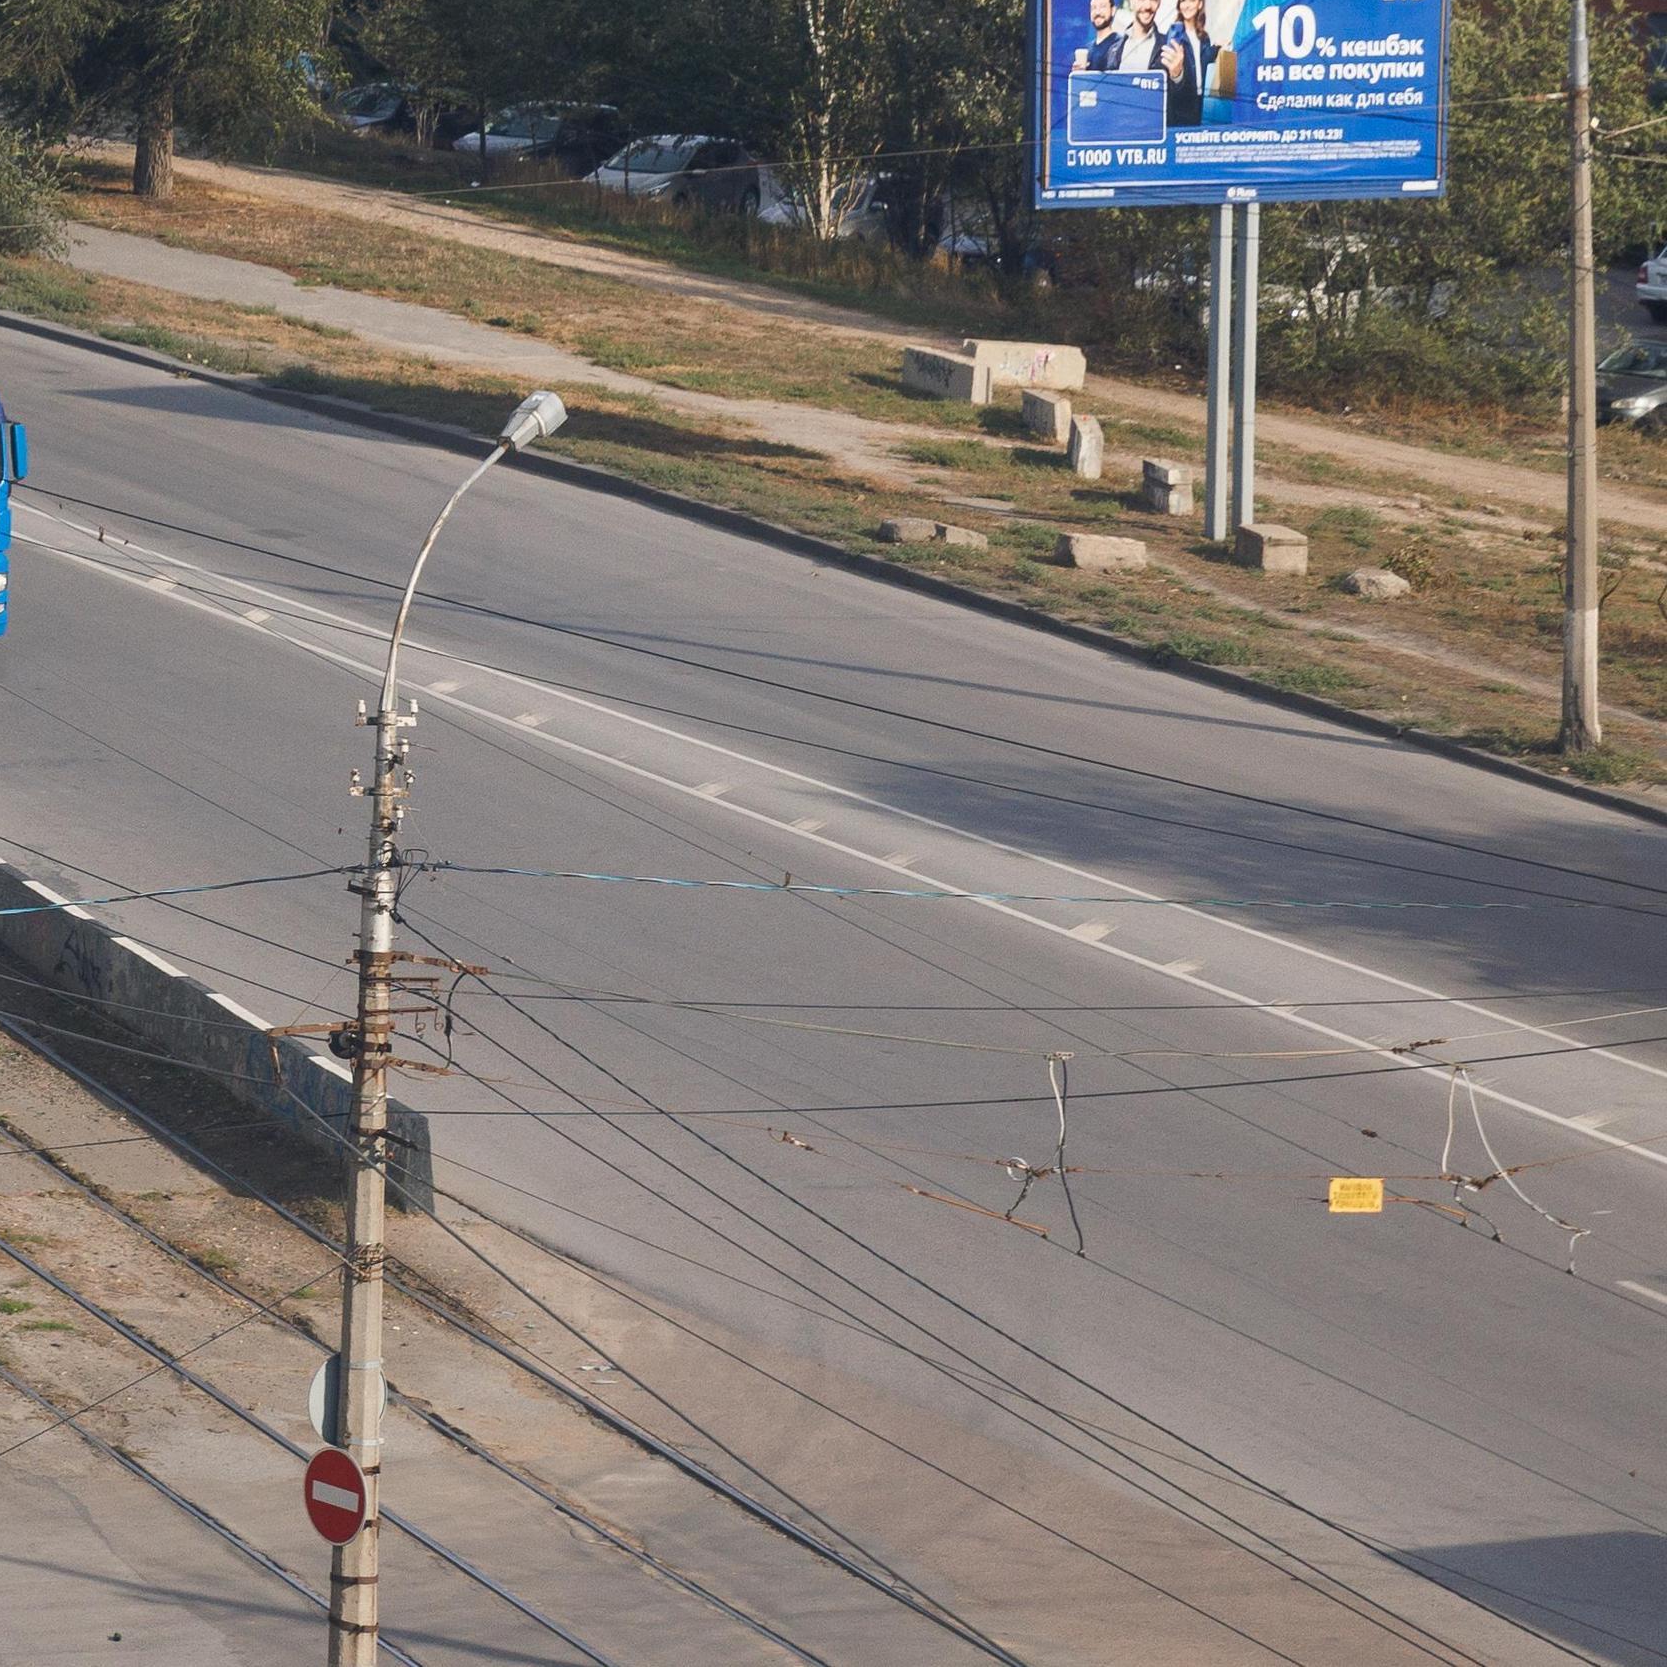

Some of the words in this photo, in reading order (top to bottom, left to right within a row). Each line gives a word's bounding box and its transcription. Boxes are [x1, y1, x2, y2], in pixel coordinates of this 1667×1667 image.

[1341, 34, 1425, 57] кешбэк
[1257, 64, 1284, 81] на
[1289, 63, 1326, 81] все
[1329, 61, 1425, 84] покупки
[1256, 92, 1323, 111] Сделали
[1326, 93, 1354, 108] как
[1355, 91, 1385, 109] для
[1388, 87, 1424, 106] себя
[1175, 129, 1221, 144] УСПЕЙТЕ
[1222, 130, 1281, 144] ОФОРМИТЬ
[1078, 148, 1112, 165] 1000
[1116, 147, 1167, 165] VTB.RU
